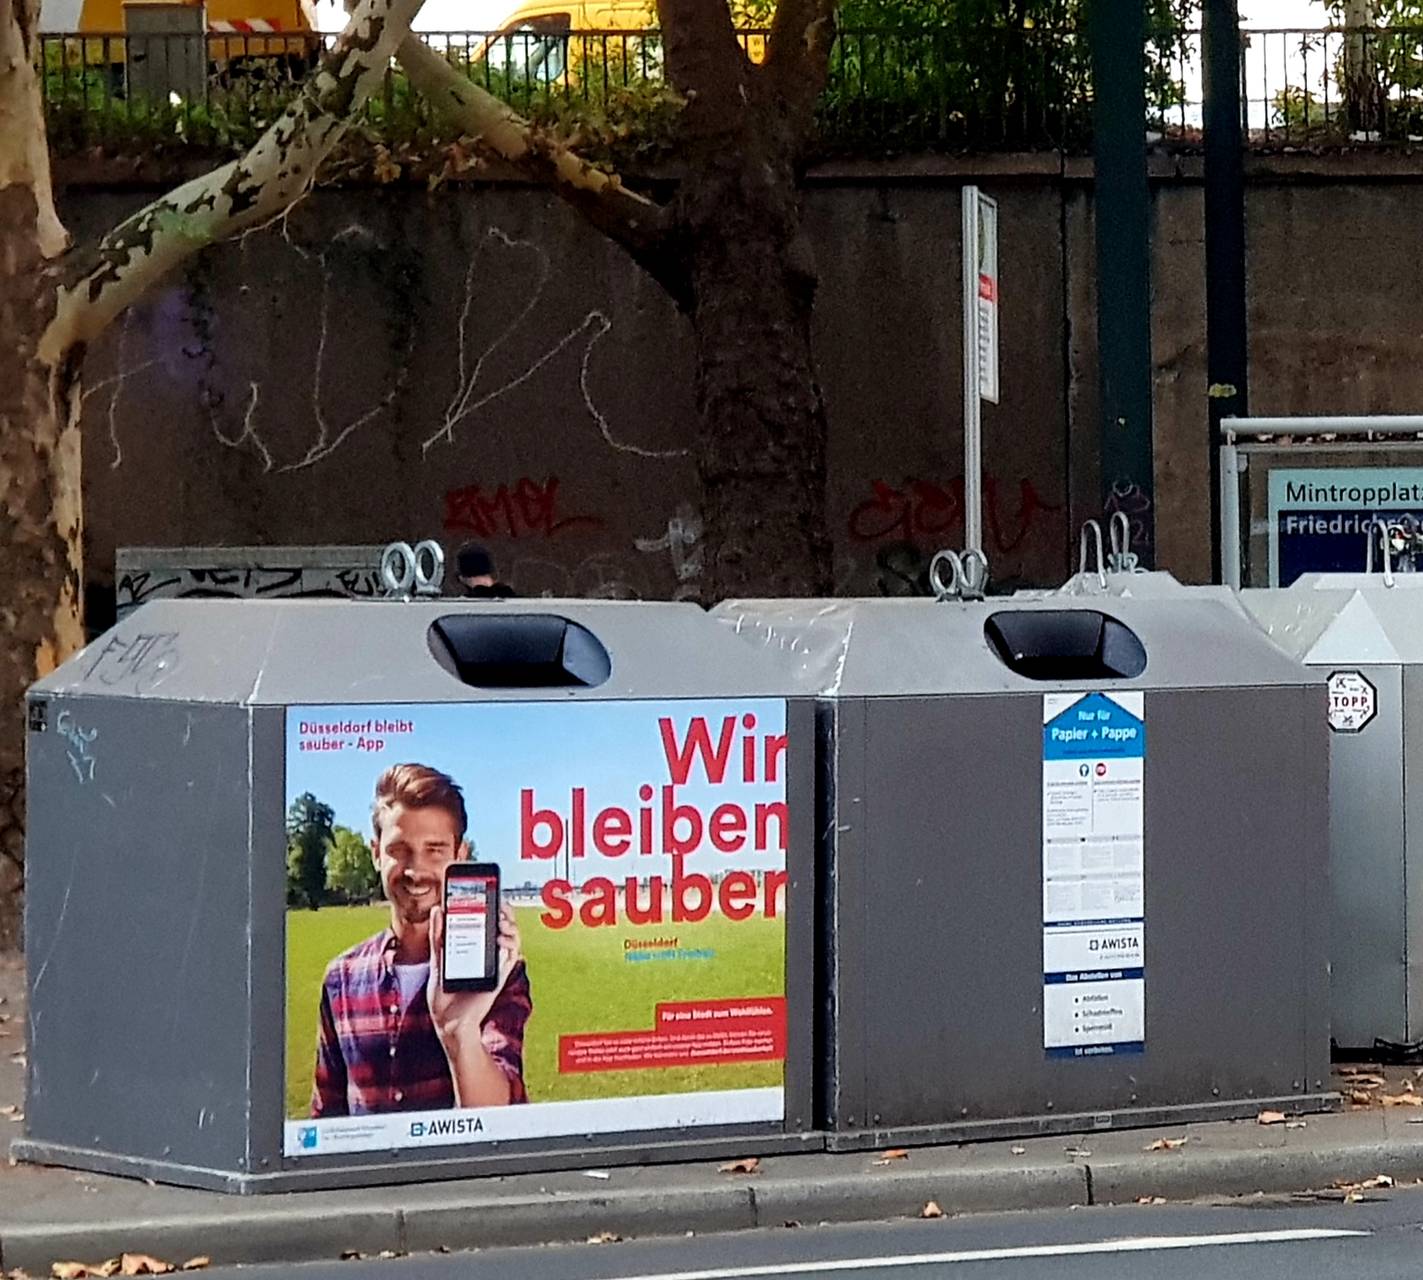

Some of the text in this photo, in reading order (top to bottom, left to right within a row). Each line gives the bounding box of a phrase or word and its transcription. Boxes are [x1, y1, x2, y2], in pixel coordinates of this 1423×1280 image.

[1333, 696, 1368, 707] TOPP
[1078, 711, 1095, 721] Nur
[299, 720, 414, 734] Düsseldorf bleibt
[1051, 726, 1137, 743] Papier + Pappe
[299, 738, 345, 751] sauber
[356, 737, 384, 751] App
[658, 713, 788, 784] Wir
[520, 784, 788, 860] bleiben
[540, 854, 788, 929] sauber
[1101, 937, 1139, 949] AWISTA
[429, 1118, 484, 1136] AWISTA
